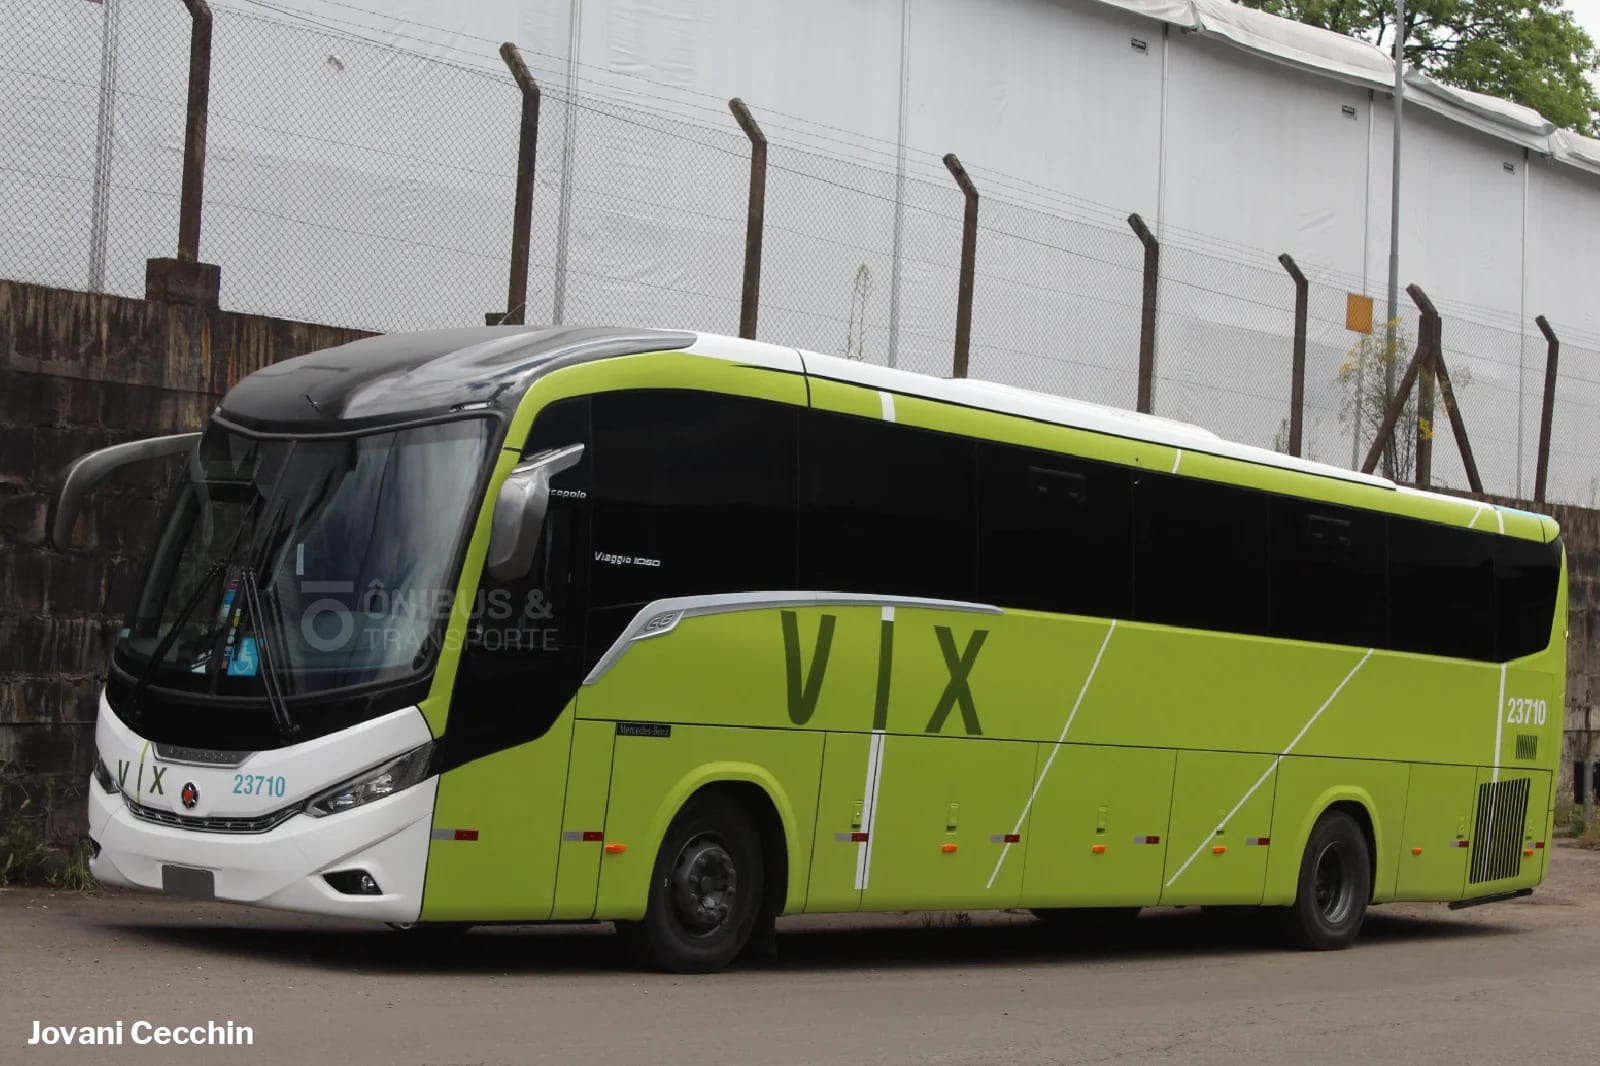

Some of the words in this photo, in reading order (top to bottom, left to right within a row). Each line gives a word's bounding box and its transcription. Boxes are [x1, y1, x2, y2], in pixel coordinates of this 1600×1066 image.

[549, 488, 587, 499] copolo
[594, 551, 632, 565] Viaggio
[781, 610, 990, 736] VIX
[1507, 698, 1546, 725] 23710
[118, 759, 167, 796] VIX
[232, 773, 286, 798] 23710
